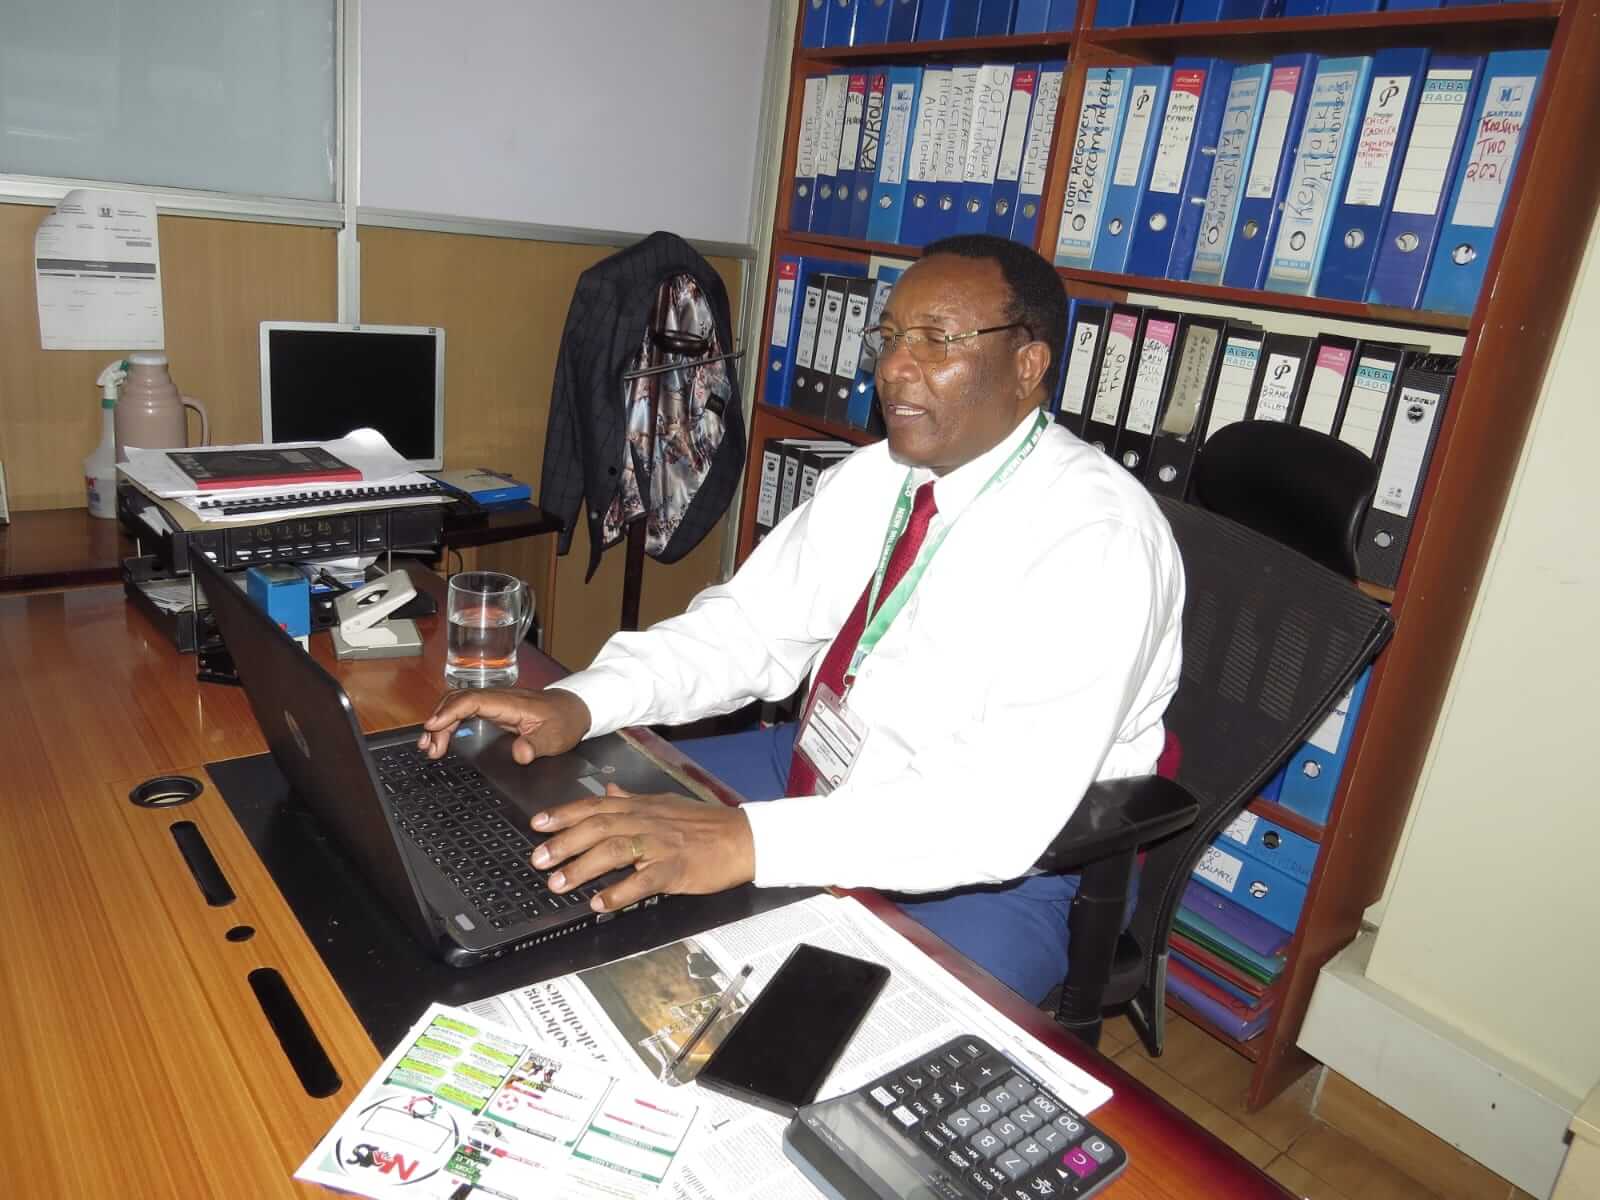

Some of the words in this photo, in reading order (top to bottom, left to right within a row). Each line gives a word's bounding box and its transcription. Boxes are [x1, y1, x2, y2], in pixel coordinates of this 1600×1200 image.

[1429, 82, 1465, 90] ALBA
[1424, 91, 1464, 102] RADO
[1226, 347, 1256, 358] ALBA
[1225, 356, 1255, 368] RADO
[1359, 368, 1391, 380] ALBA
[1356, 378, 1389, 390] RADO
[522, 988, 569, 1048] sobering
[546, 983, 594, 1050] alcoholics
[995, 1091, 1010, 1103] 3
[977, 1103, 992, 1113] 6
[1033, 1096, 1056, 1114] 000
[956, 1117, 971, 1127] 9
[1019, 1110, 1036, 1123] 2
[1000, 1123, 1015, 1135] 5
[1058, 1115, 1080, 1133] 00
[980, 1135, 996, 1147] 8
[1045, 1131, 1057, 1142] 1
[1025, 1143, 1040, 1153] 4
[1090, 1141, 1105, 1152] 0
[1004, 1159, 1021, 1169] 7
[1072, 1152, 1087, 1165] C
